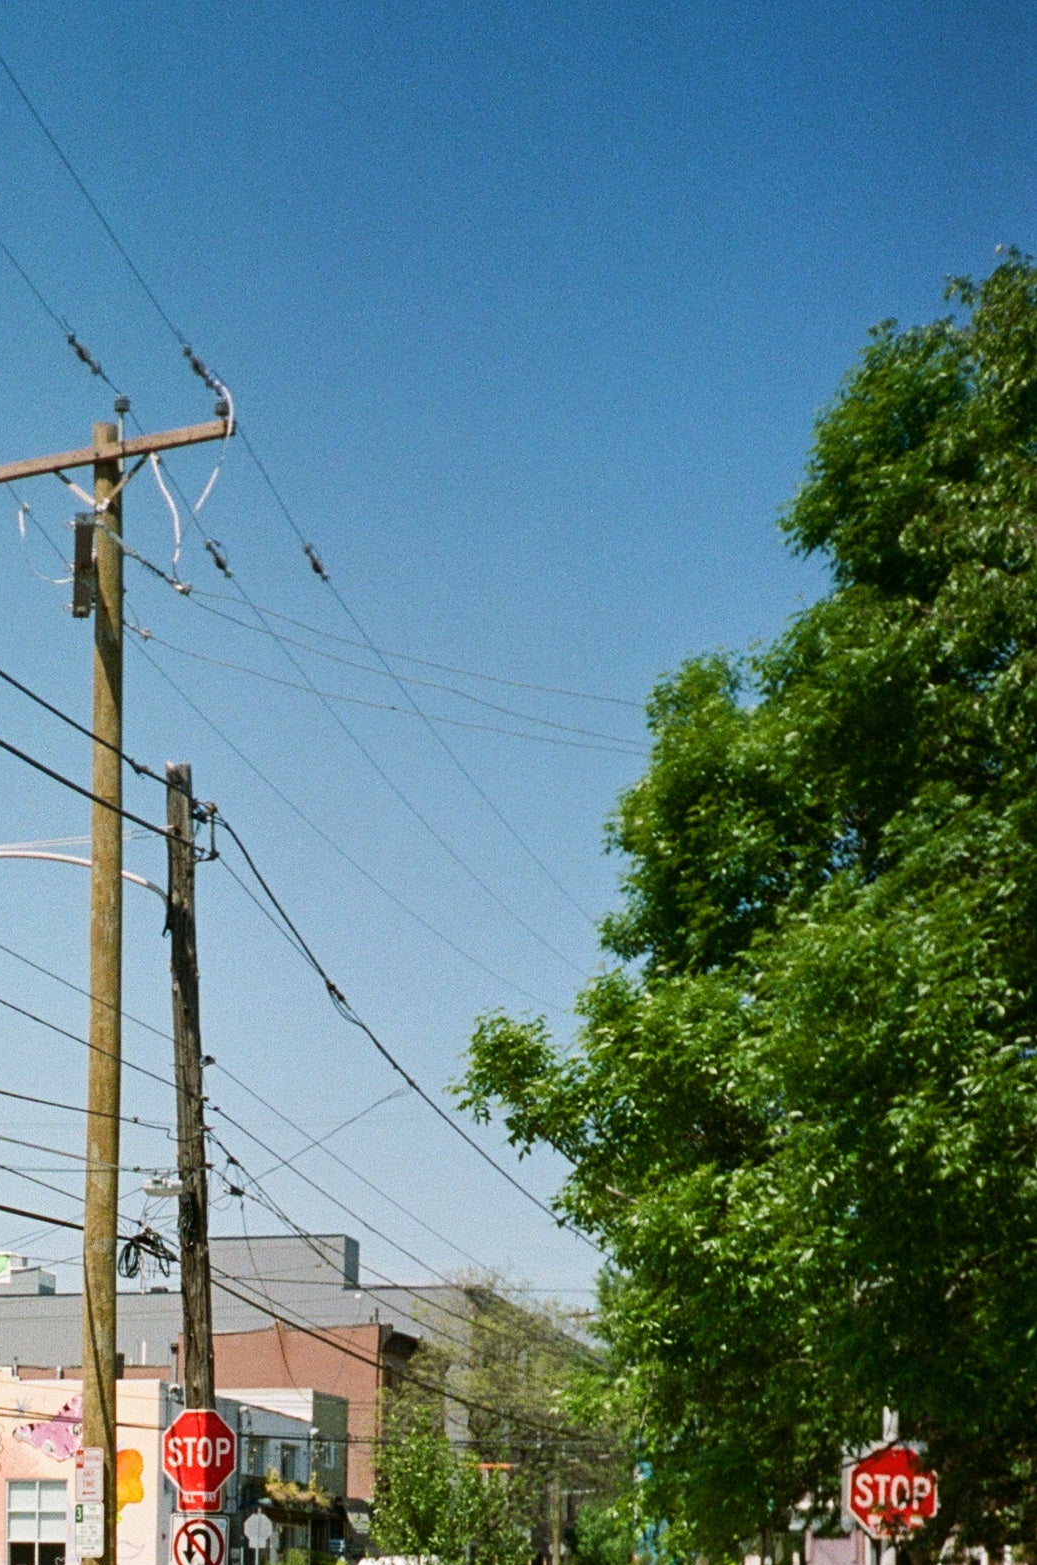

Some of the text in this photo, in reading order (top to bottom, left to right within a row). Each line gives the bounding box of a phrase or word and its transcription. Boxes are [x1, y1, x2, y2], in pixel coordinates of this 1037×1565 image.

[167, 1436, 231, 1468] STOP
[182, 1493, 217, 1503] ALL WAY
[855, 1473, 931, 1511] STOP
[76, 1506, 82, 1521] 3
